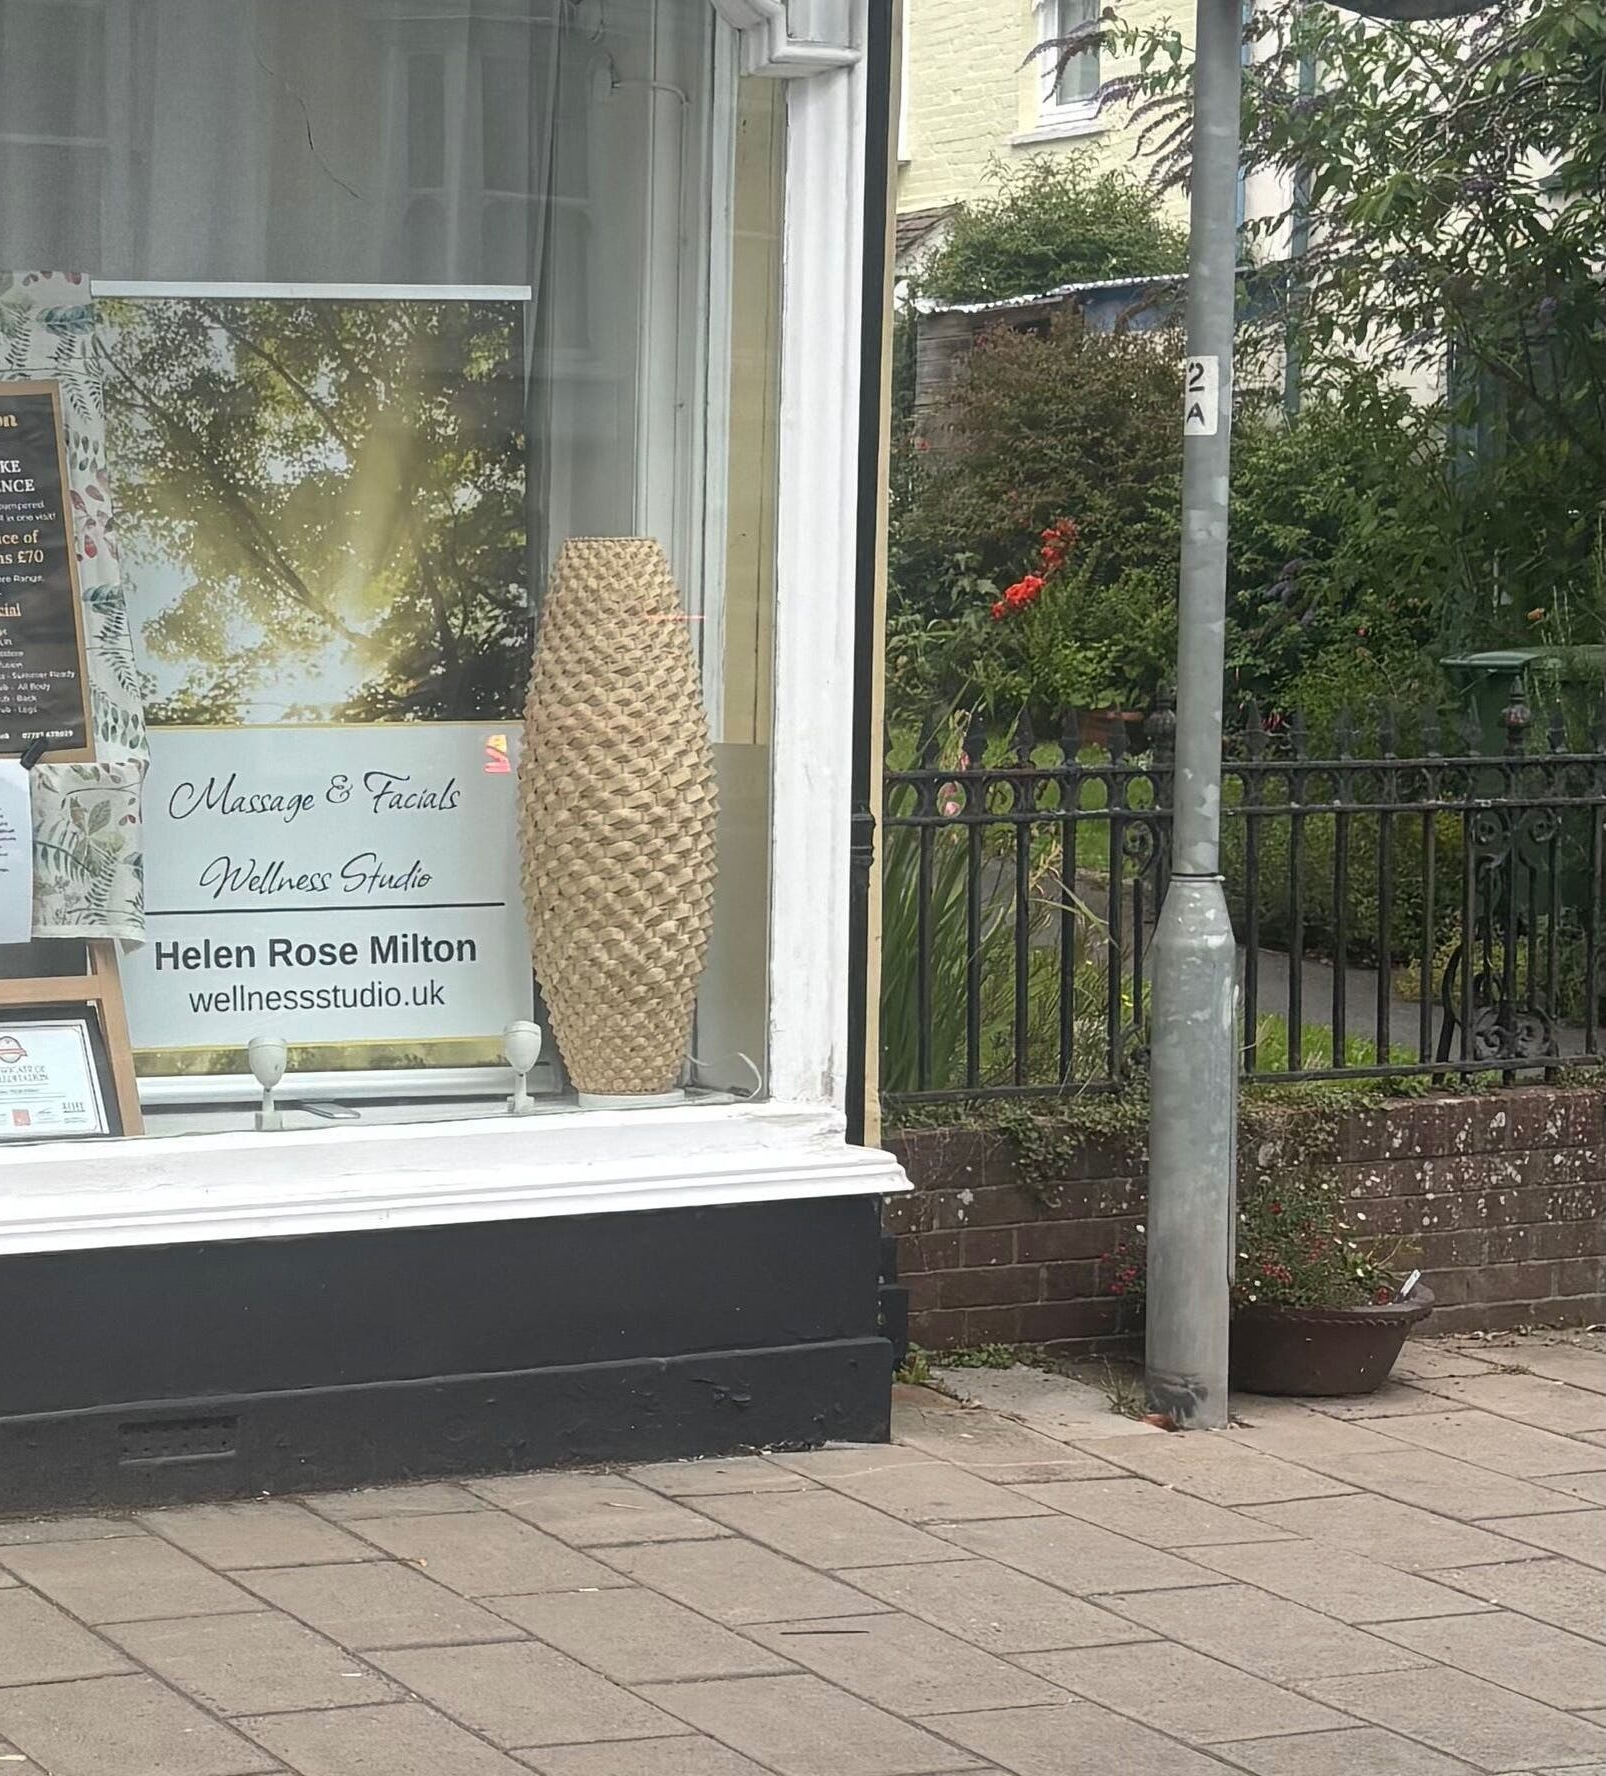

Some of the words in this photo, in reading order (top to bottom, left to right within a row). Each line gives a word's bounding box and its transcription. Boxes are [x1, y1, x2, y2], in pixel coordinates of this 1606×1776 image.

[1188, 362, 1205, 392] 2
[1186, 402, 1205, 426] A
[23, 530, 39, 543] of
[17, 550, 44, 563] £70
[168, 772, 315, 823] Massage
[324, 774, 354, 804] &
[363, 770, 461, 815] Facials
[199, 855, 332, 899] Wellness
[339, 852, 434, 894] Studio
[155, 939, 256, 970] Helen
[269, 938, 358, 967] Rose
[370, 934, 477, 965] Milton
[189, 980, 445, 1013] wellnessstudio.uk
